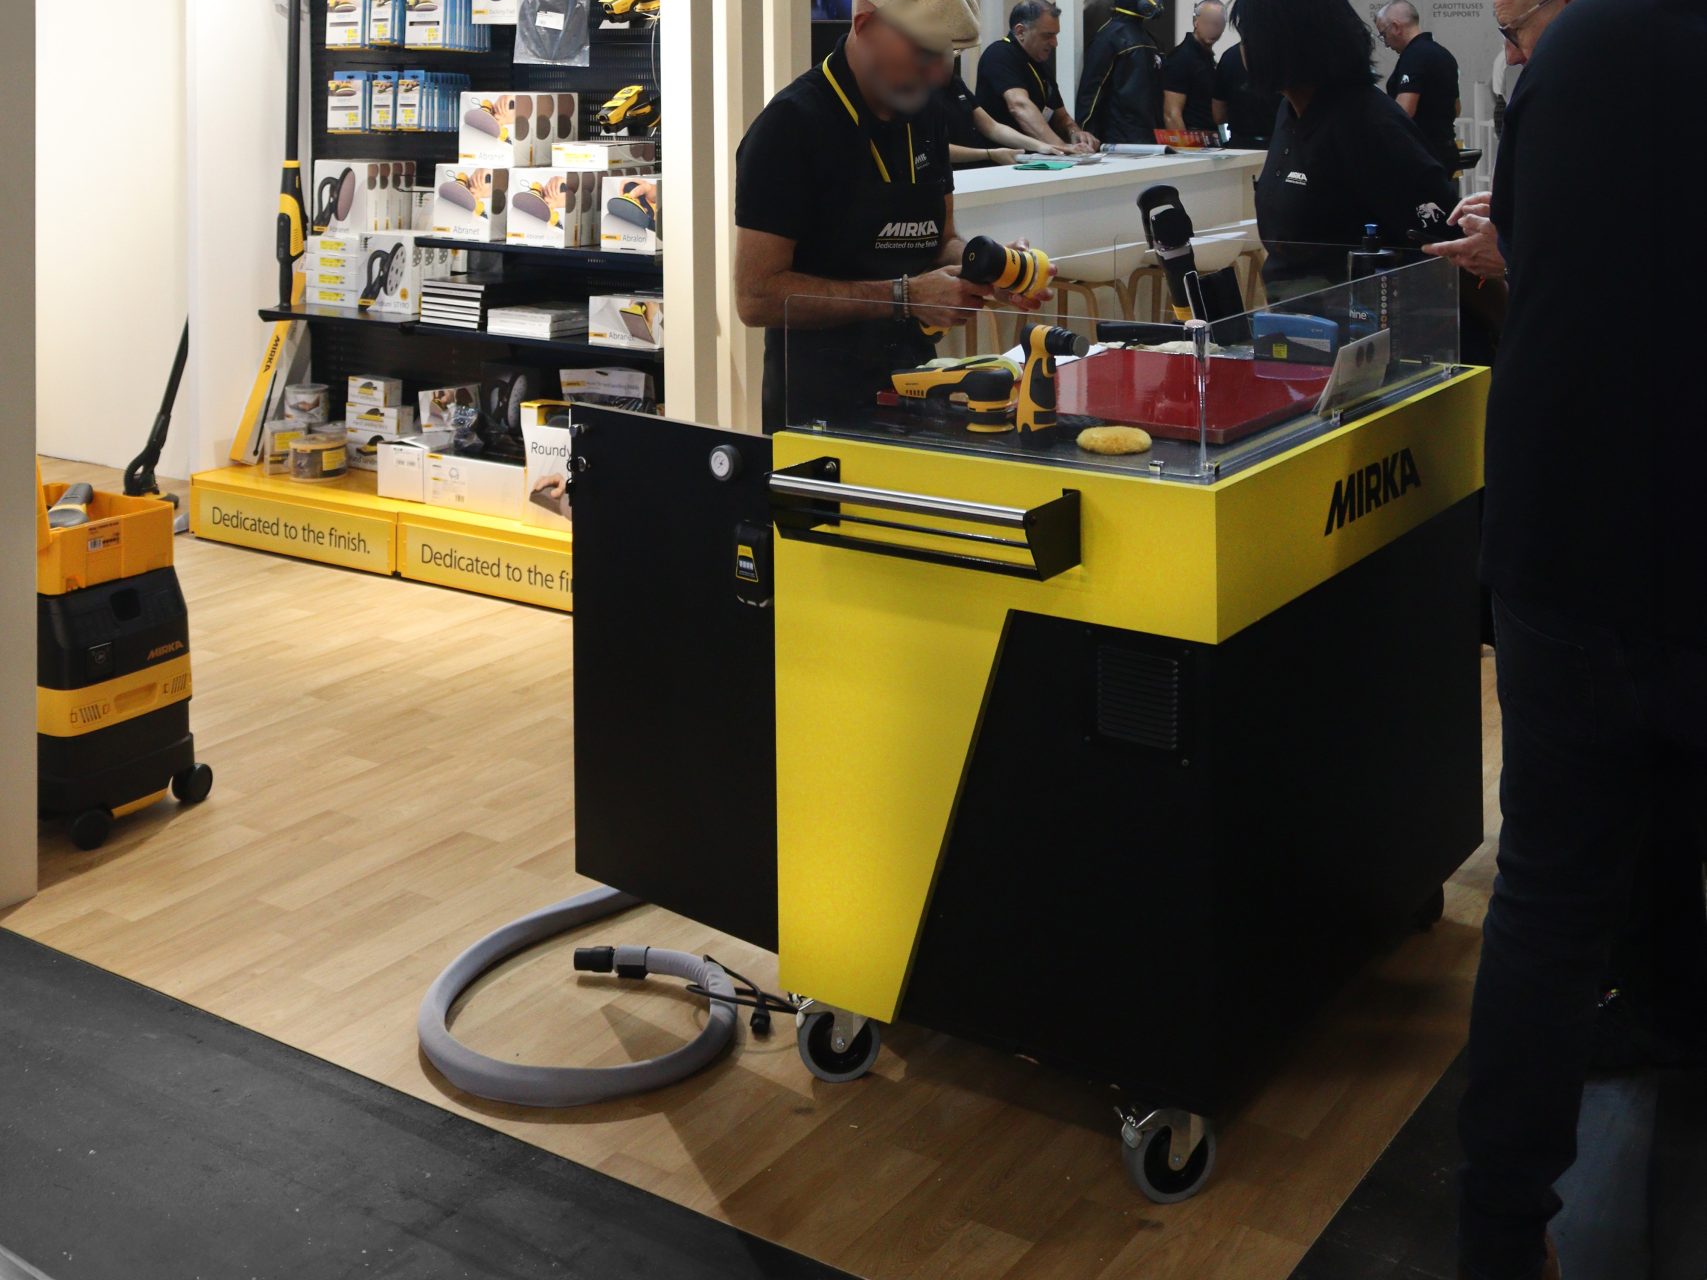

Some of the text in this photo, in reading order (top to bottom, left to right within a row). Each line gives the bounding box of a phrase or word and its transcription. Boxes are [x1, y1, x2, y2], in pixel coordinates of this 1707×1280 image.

[1432, 2, 1484, 10] CAROTTEUSES
[478, 151, 504, 159] Abranet
[452, 225, 480, 235] Abranet
[878, 220, 939, 237] MIRKA
[622, 234, 647, 243] Abralon
[875, 241, 907, 249] Dedicated
[907, 241, 914, 249] to
[263, 334, 280, 373] MIRKA
[1324, 447, 1422, 537] MIRKA
[212, 506, 371, 555] Dedicated to the finish.
[421, 543, 573, 594] Dedicated to the fi
[147, 640, 184, 660] MIRKA
